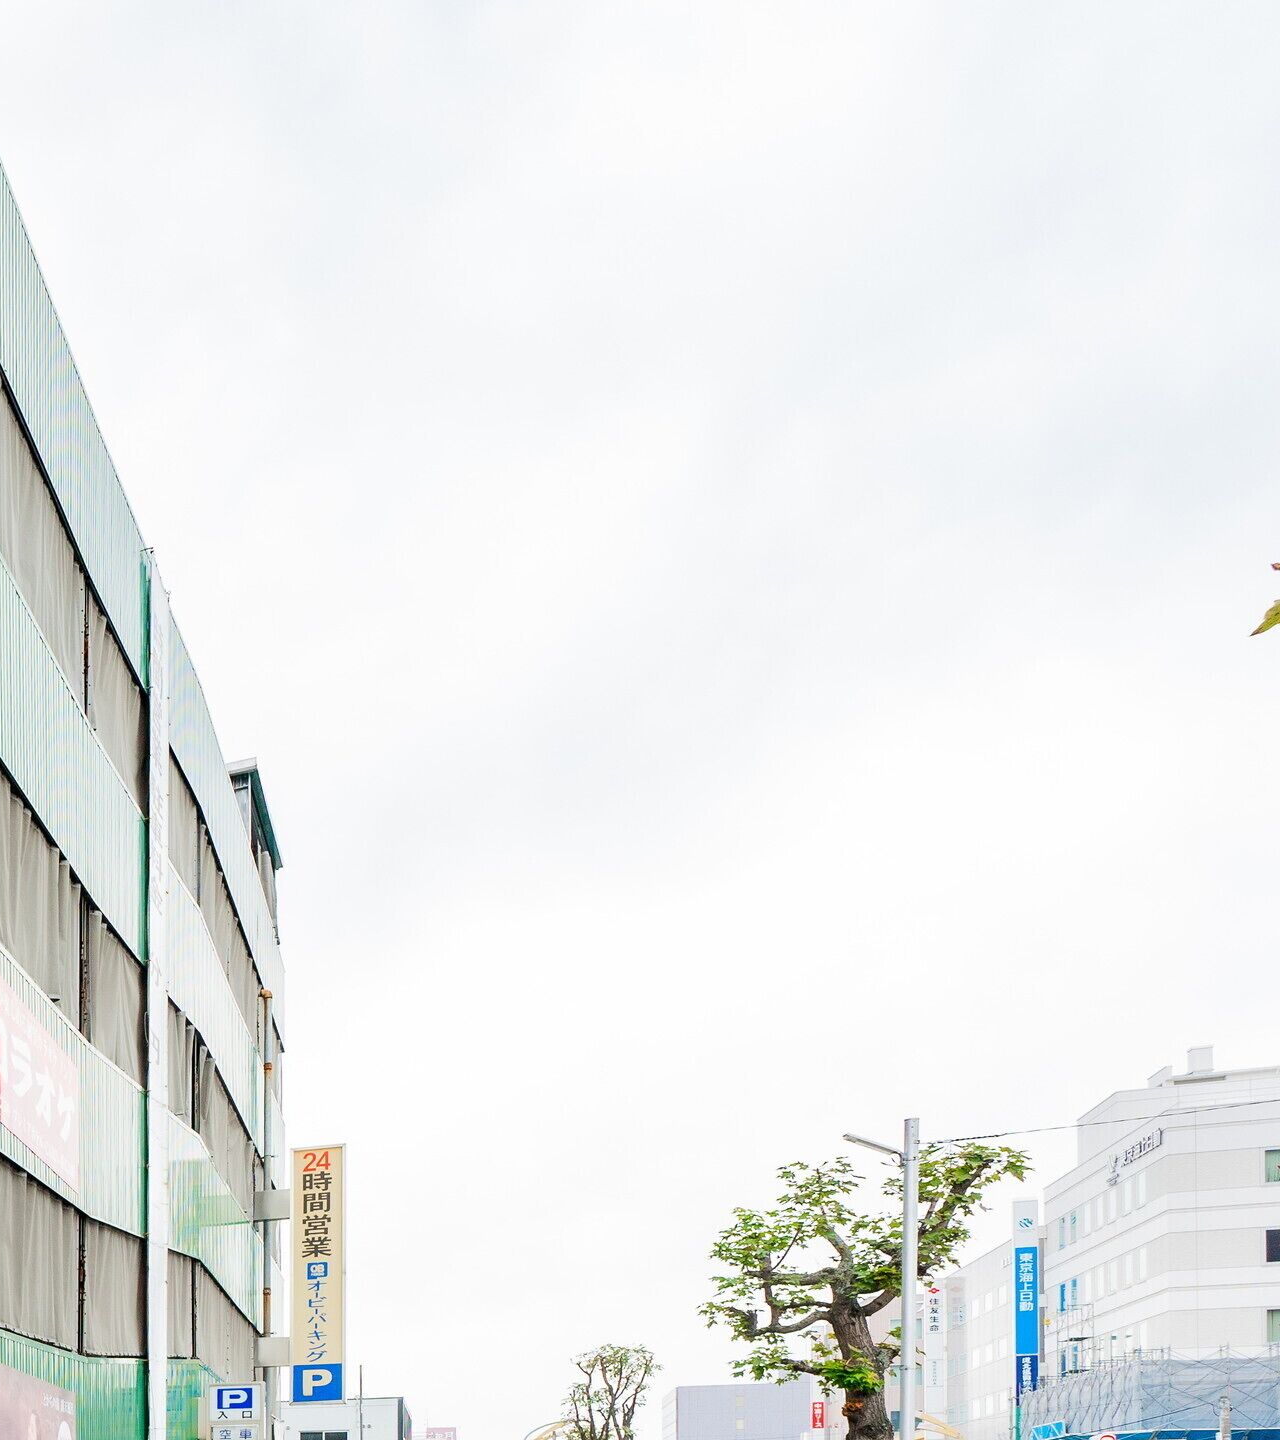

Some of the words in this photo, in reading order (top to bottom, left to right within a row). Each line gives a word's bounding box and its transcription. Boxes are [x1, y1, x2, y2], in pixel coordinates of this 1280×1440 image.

[302, 1151, 332, 1258] 24時間営業
[1019, 1253, 1034, 1312] 東京海上日動
[307, 1281, 327, 1362] オービーパーキング
[302, 1369, 333, 1397] P
[222, 1389, 248, 1409] P
[218, 1410, 253, 1419] 入口
[219, 1429, 252, 1440] 空車
